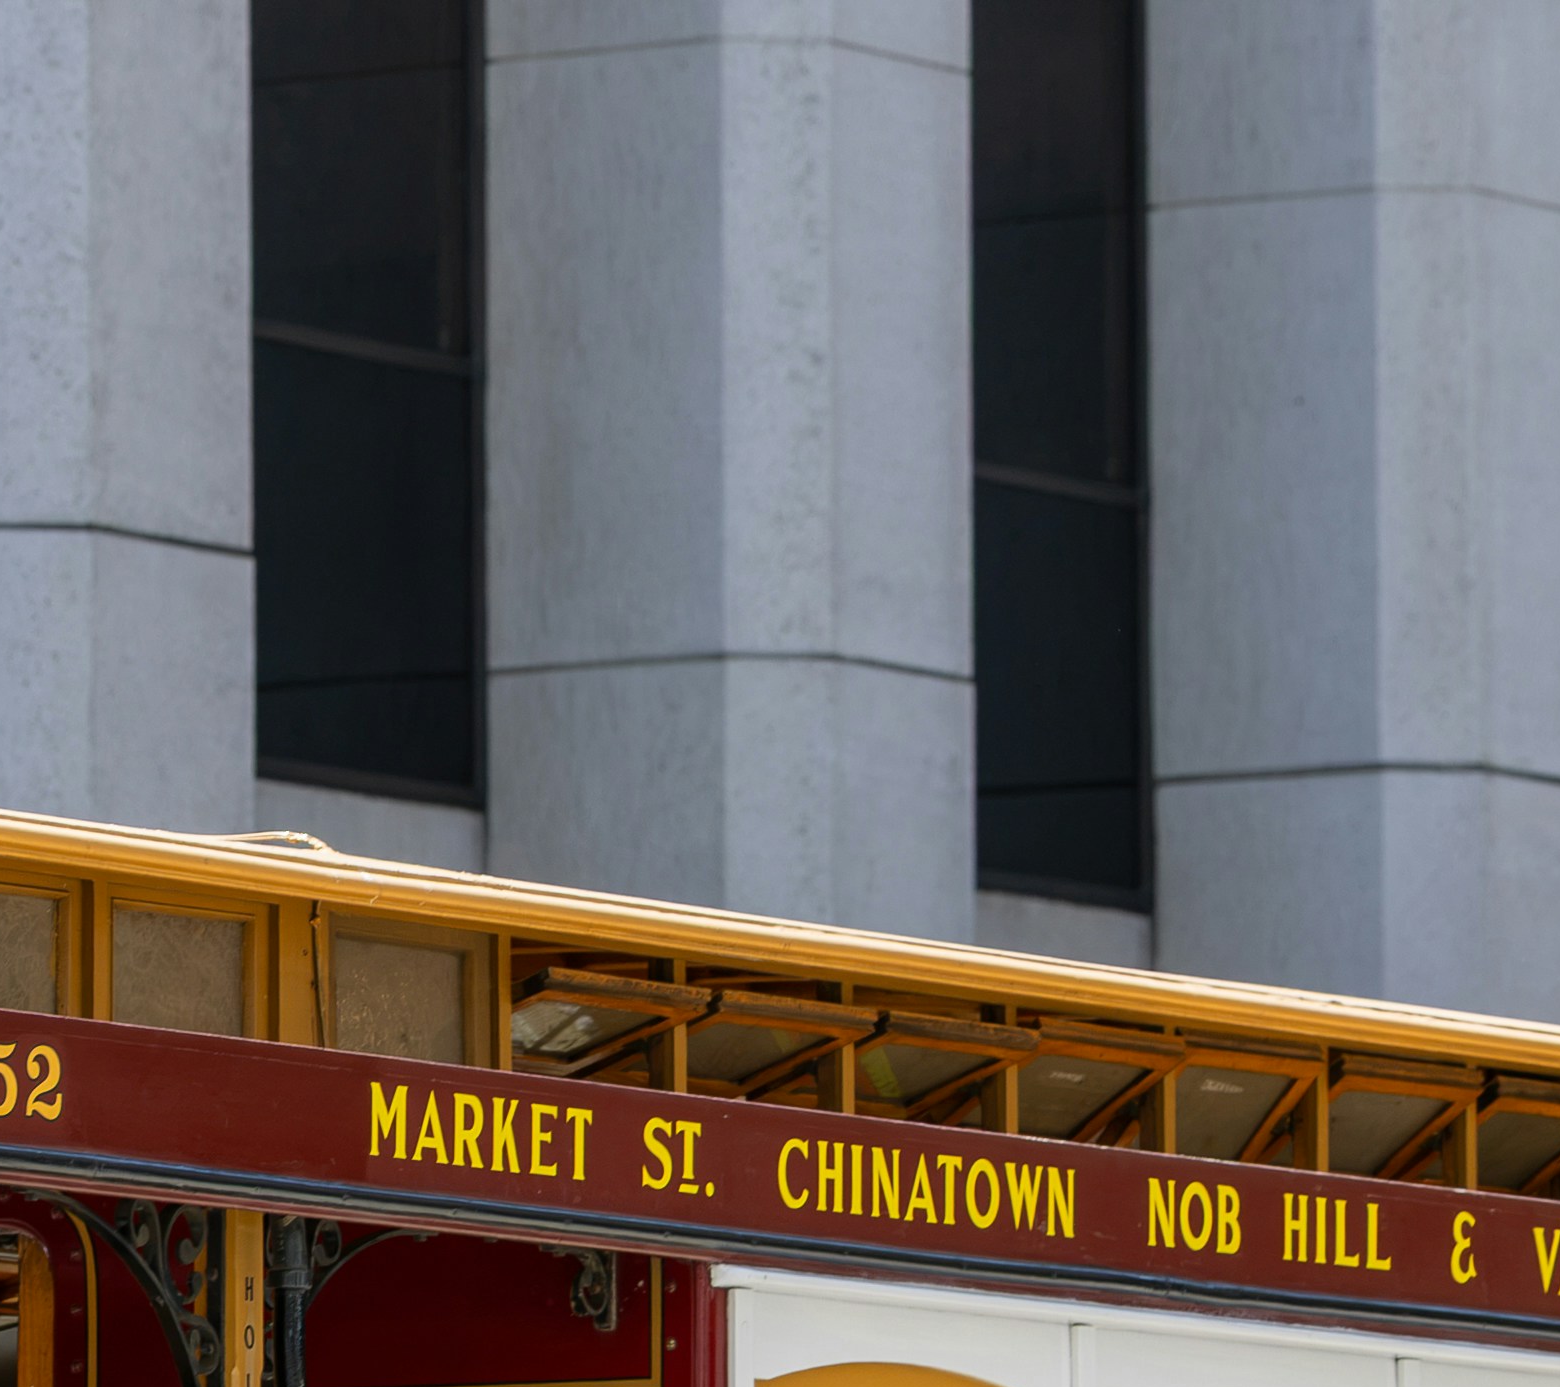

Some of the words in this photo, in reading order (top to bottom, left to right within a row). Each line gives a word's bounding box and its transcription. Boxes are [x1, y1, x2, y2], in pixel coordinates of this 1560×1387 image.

[369, 1080, 593, 1185] MARKET
[642, 1116, 717, 1198] ST.
[779, 1138, 1077, 1239] CHINATOWN
[1147, 1175, 1244, 1256] NOB
[1283, 1192, 1392, 1273] HILL
[1450, 1210, 1477, 1286] &
